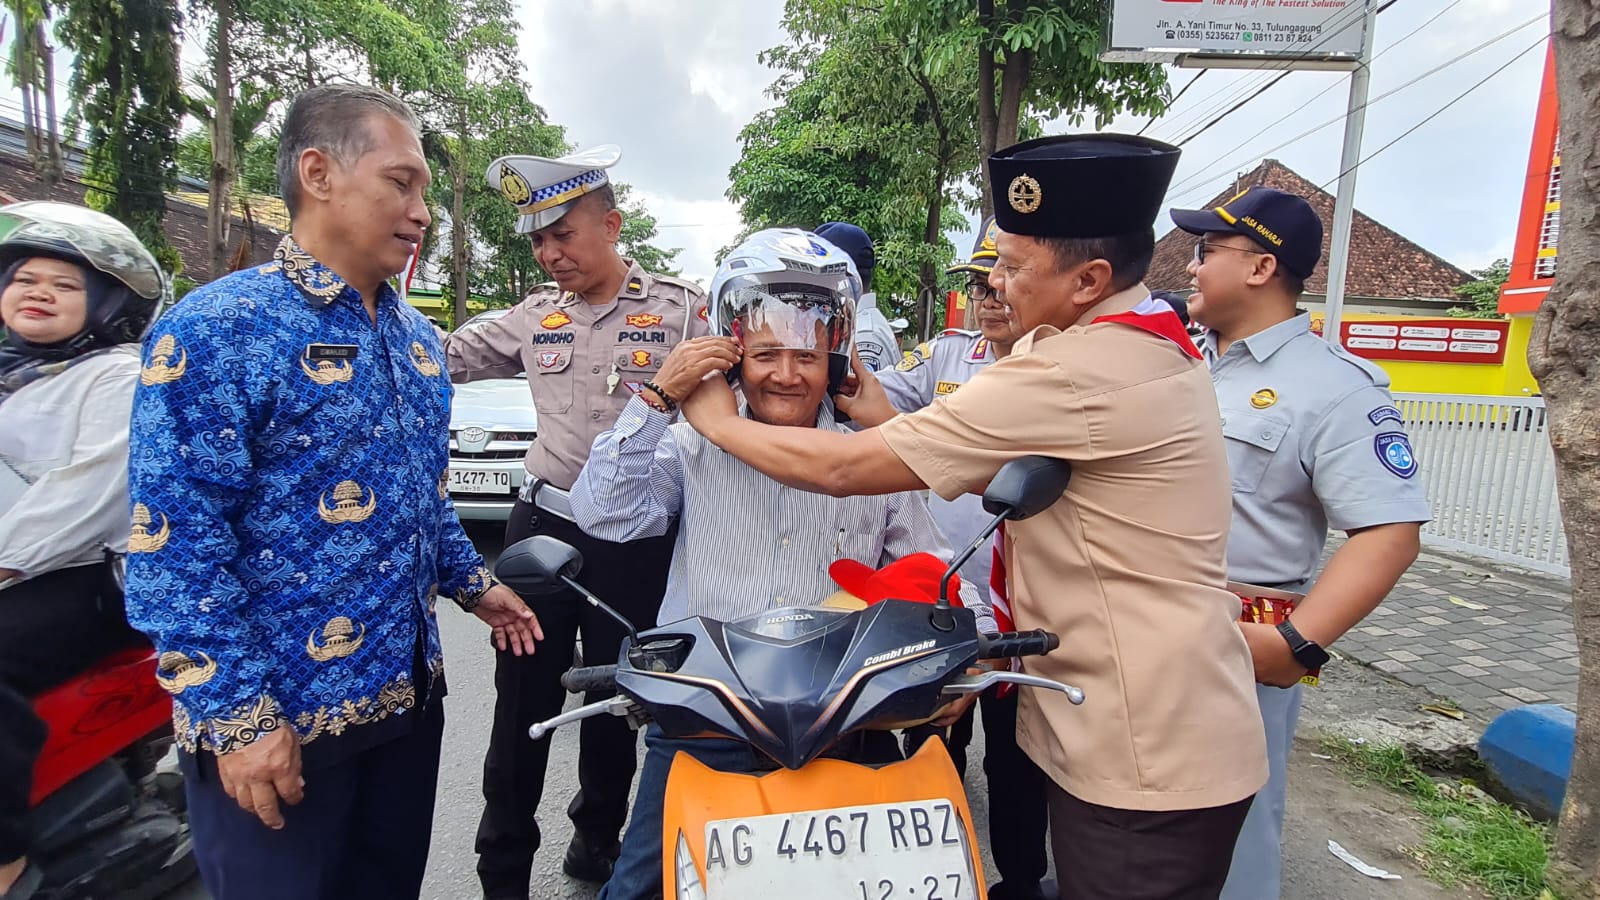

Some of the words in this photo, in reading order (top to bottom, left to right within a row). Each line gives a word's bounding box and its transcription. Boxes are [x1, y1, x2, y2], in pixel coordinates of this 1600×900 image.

[1229, 0, 1248, 8] King
[1250, 0, 1259, 8] of
[1311, 0, 1346, 8] Solution
[1188, 21, 1206, 30] Yani
[1208, 21, 1232, 30] Timur
[1235, 22, 1249, 31] No.
[1252, 22, 1264, 32] 33,
[1267, 22, 1322, 34] Tulungagung
[1177, 30, 1203, 40] (0355)
[1205, 31, 1240, 40] 5235627
[1254, 33, 1272, 42] 0811
[1275, 34, 1284, 42] 23
[1286, 34, 1296, 42] 87
[1298, 34, 1312, 43] 824
[1241, 215, 1258, 228] JASA
[1256, 224, 1283, 247] RAHARJA
[532, 331, 575, 345] NONDHO
[618, 331, 666, 343] POLRI
[455, 471, 486, 485] 1477
[493, 472, 509, 485] TQ
[767, 613, 815, 625] HONDA
[863, 647, 902, 667] Combi
[902, 639, 937, 656] Brake
[706, 825, 753, 871] AG
[777, 812, 869, 860] 4467
[887, 804, 960, 849] RBZ
